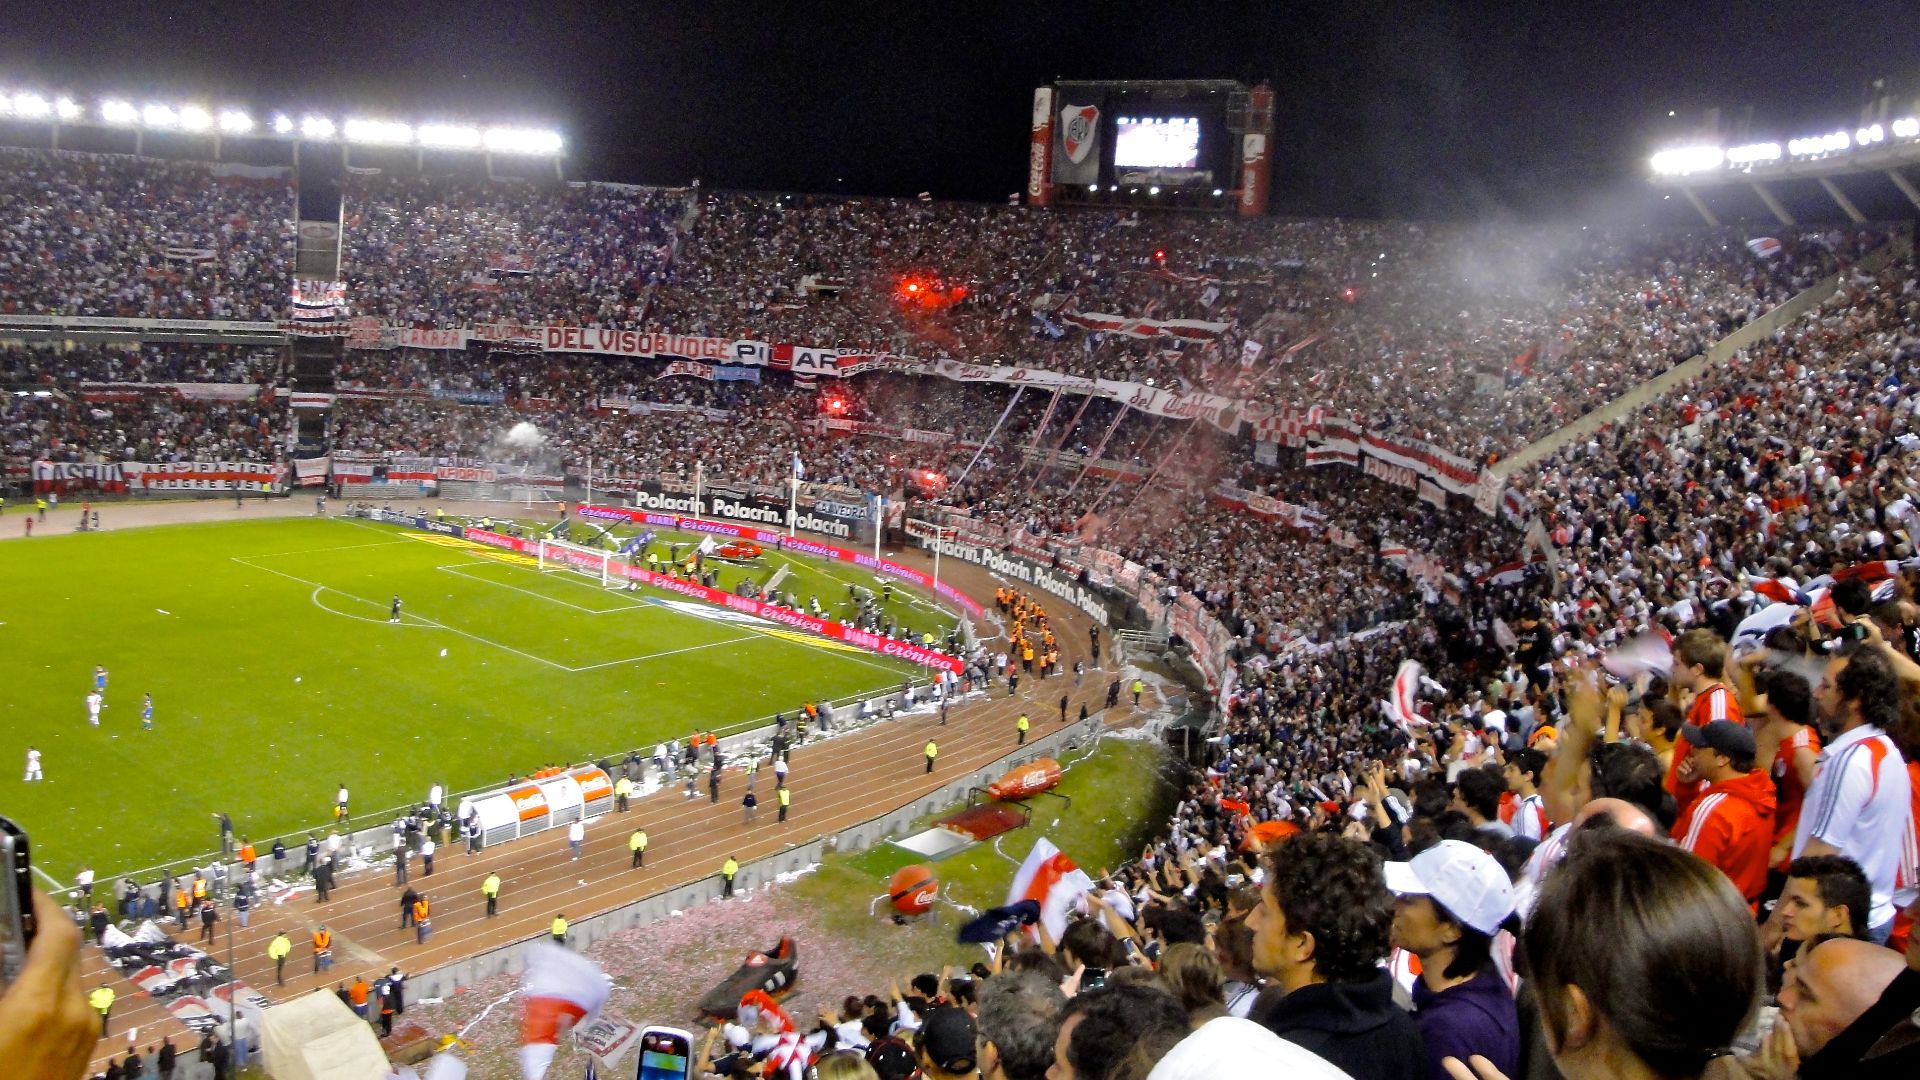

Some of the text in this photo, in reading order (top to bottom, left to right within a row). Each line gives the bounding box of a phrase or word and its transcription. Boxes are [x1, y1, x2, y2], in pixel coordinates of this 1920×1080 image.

[548, 328, 594, 349] DEL
[600, 330, 652, 353] VISO
[654, 335, 731, 359] BUDGE
[1129, 387, 1157, 410] del
[636, 491, 706, 513] Polacrin
[713, 499, 782, 523] Polacrin.
